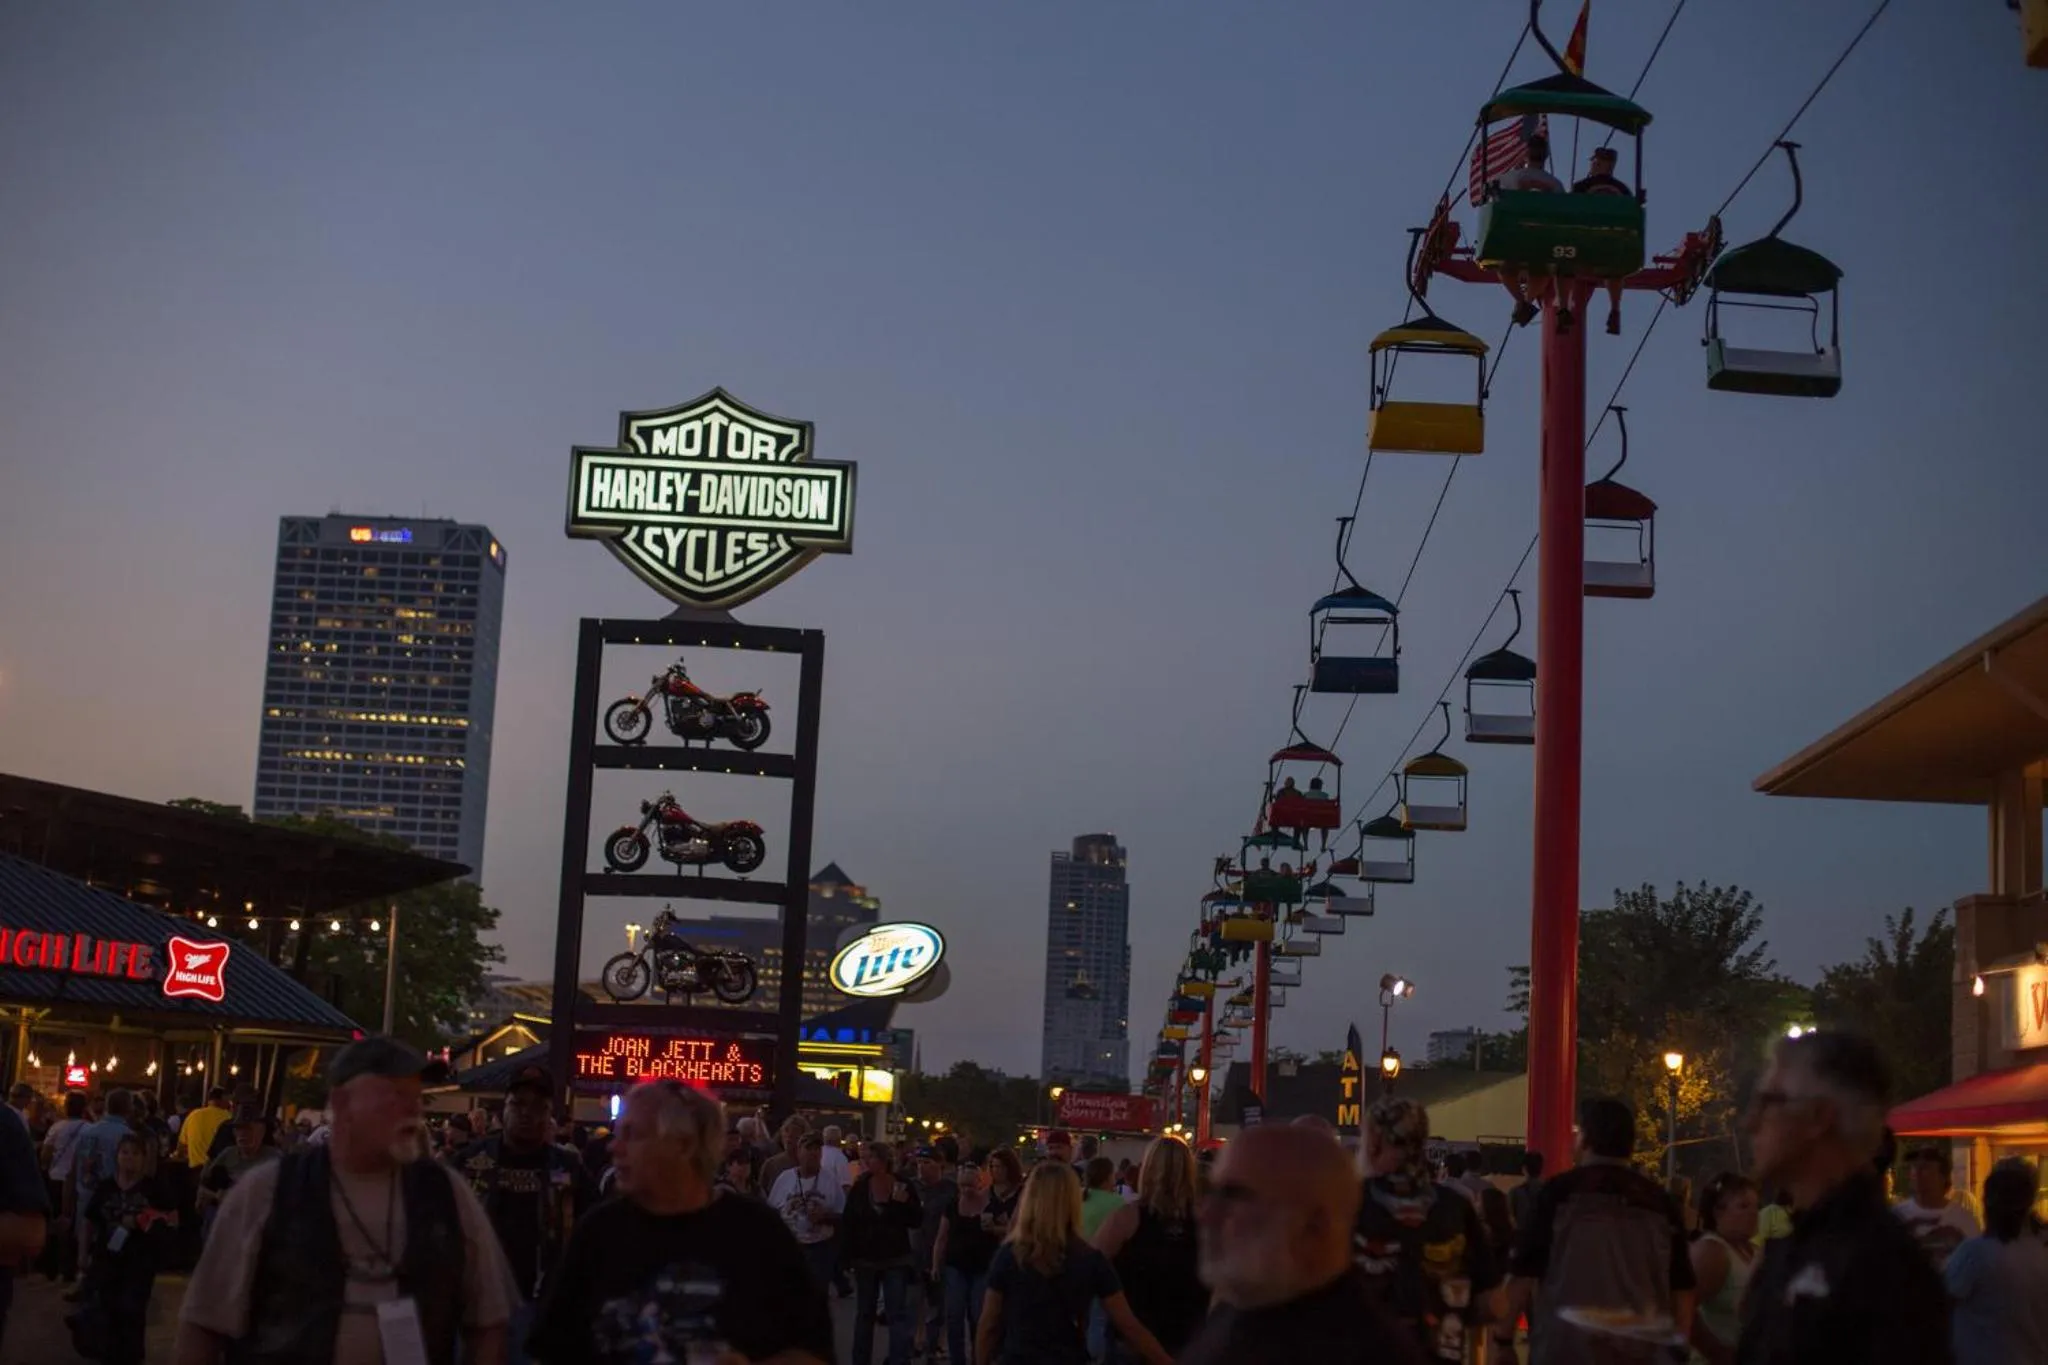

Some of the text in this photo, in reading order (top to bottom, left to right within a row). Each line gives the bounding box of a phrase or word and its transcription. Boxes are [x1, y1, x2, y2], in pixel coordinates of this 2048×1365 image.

[1553, 246, 1576, 258] 93
[651, 411, 777, 462] MOTOR
[590, 466, 830, 521] HARLEY-DAVIDSON
[642, 526, 771, 583] CYCLES
[0, 926, 153, 980] IGH LIFE
[852, 945, 925, 988] Lite
[576, 1054, 763, 1082] THE BLACKHEARTS
[602, 1036, 741, 1062] JOAN JETT &
[1337, 1050, 1360, 1127] ATM
